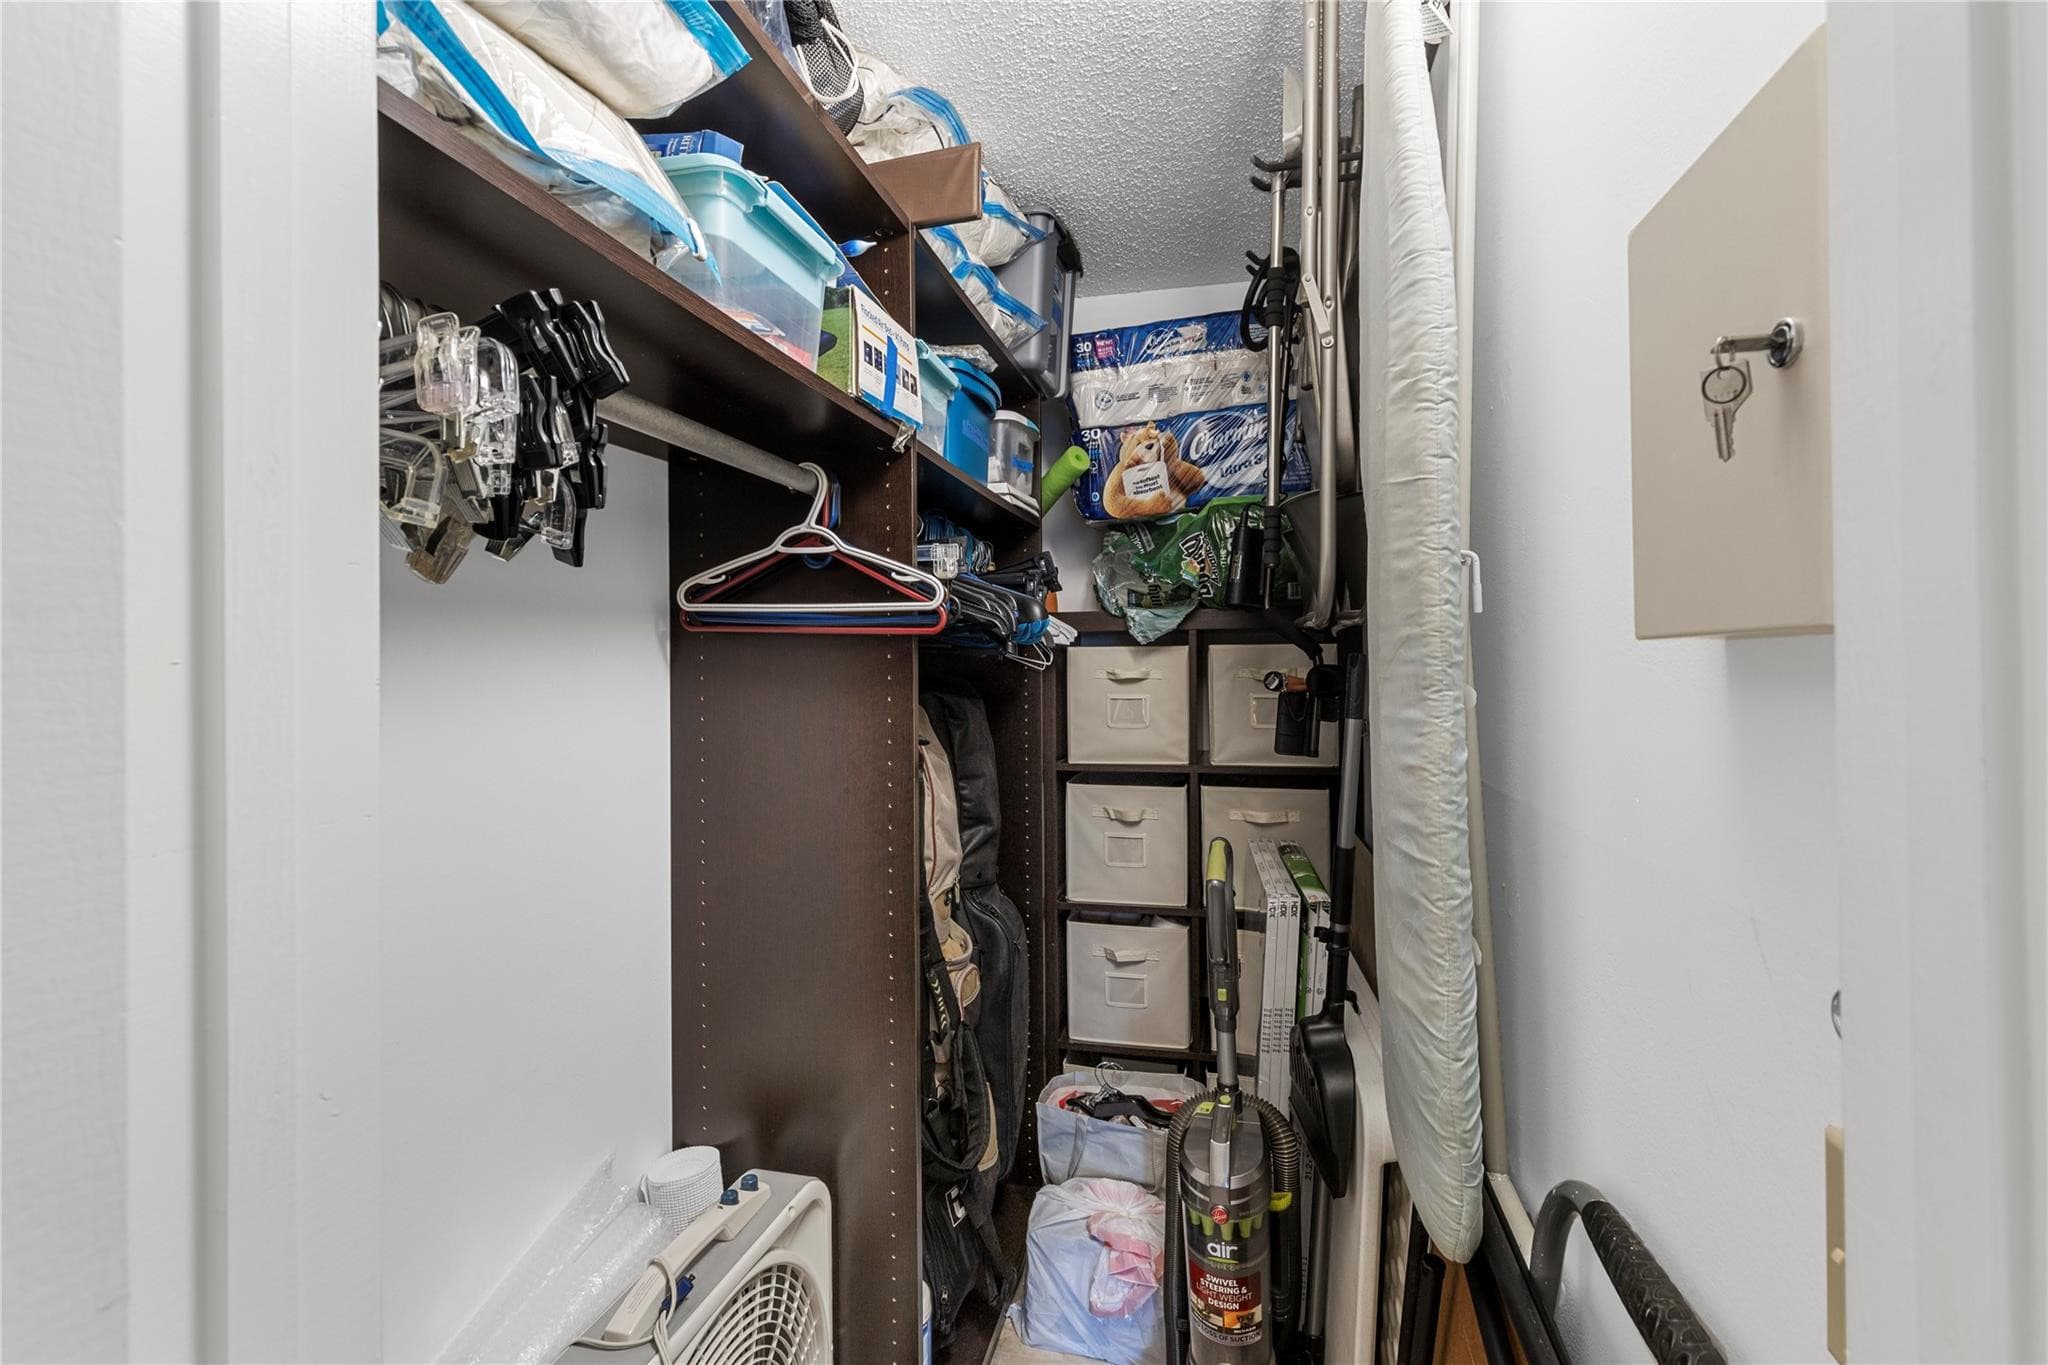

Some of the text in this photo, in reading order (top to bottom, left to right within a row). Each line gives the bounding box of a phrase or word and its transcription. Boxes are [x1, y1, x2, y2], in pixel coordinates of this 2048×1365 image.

[1076, 341, 1092, 353] 30
[1081, 428, 1101, 442] 30
[1279, 900, 1288, 918] HDX
[1290, 900, 1299, 918] HDX
[1207, 1241, 1238, 1259] air
[1200, 1277, 1248, 1295] STEERING &
[1205, 1273, 1239, 1287] SWIVEL
[1196, 1281, 1253, 1303] LIGHT WEIGHT
[1208, 1297, 1240, 1310] DESIGN
[1200, 1323, 1217, 1338] LOSS
[1218, 1334, 1229, 1342] OF
[1230, 1331, 1261, 1343] SUCTION
